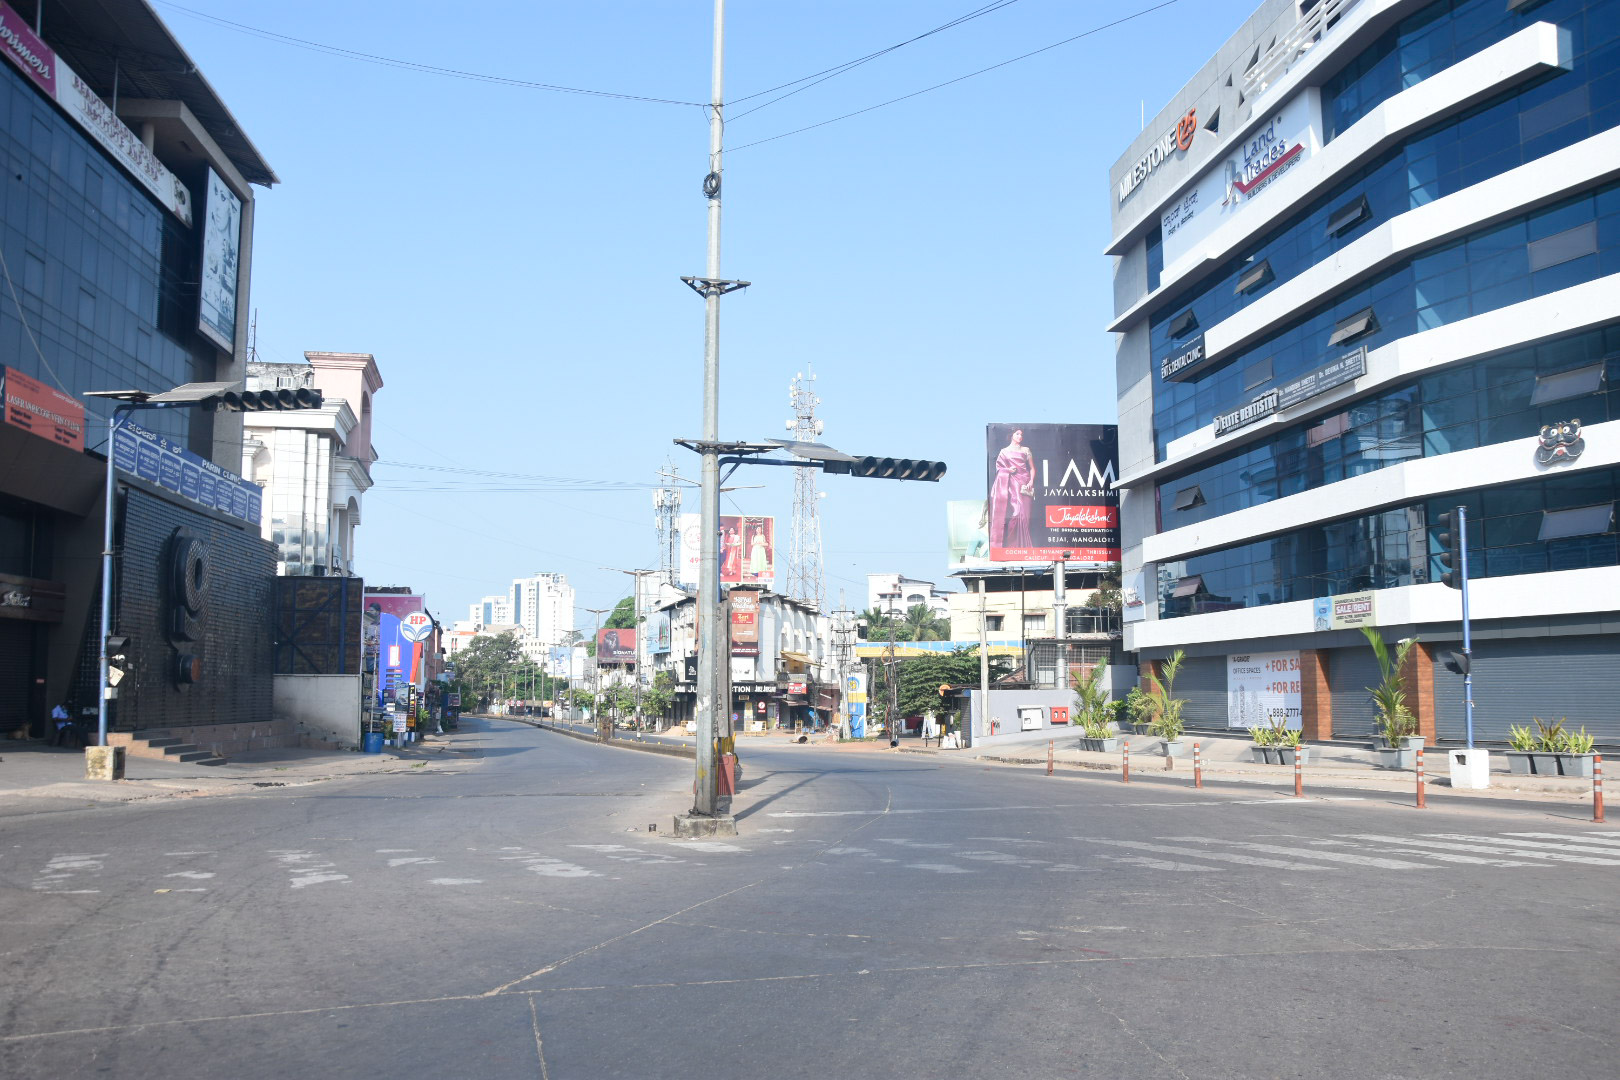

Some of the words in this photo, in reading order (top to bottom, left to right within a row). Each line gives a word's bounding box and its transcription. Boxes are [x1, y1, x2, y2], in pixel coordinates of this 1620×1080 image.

[1243, 120, 1276, 163] Land
[1119, 127, 1178, 202] MILESTONE
[1243, 138, 1287, 181] Trades
[1247, 181, 1268, 200] BUILDERS
[1272, 154, 1302, 183] DEVELOPERS
[1186, 345, 1202, 365] CLINIC
[1221, 410, 1240, 430] ELITE
[1239, 392, 1278, 422] DENTISTRY
[202, 459, 221, 474] PARIN
[222, 469, 242, 485] CLINIC
[1042, 459, 1049, 488] I
[1059, 458, 1117, 489] AM
[1043, 488, 1119, 497] JAYALAKSHMI
[1049, 507, 1112, 527] Jayalakshmi
[1047, 536, 1069, 544] BEJAI,
[410, 616, 425, 624] HP
[1271, 659, 1288, 672] FOR
[1272, 682, 1288, 694] FOR
